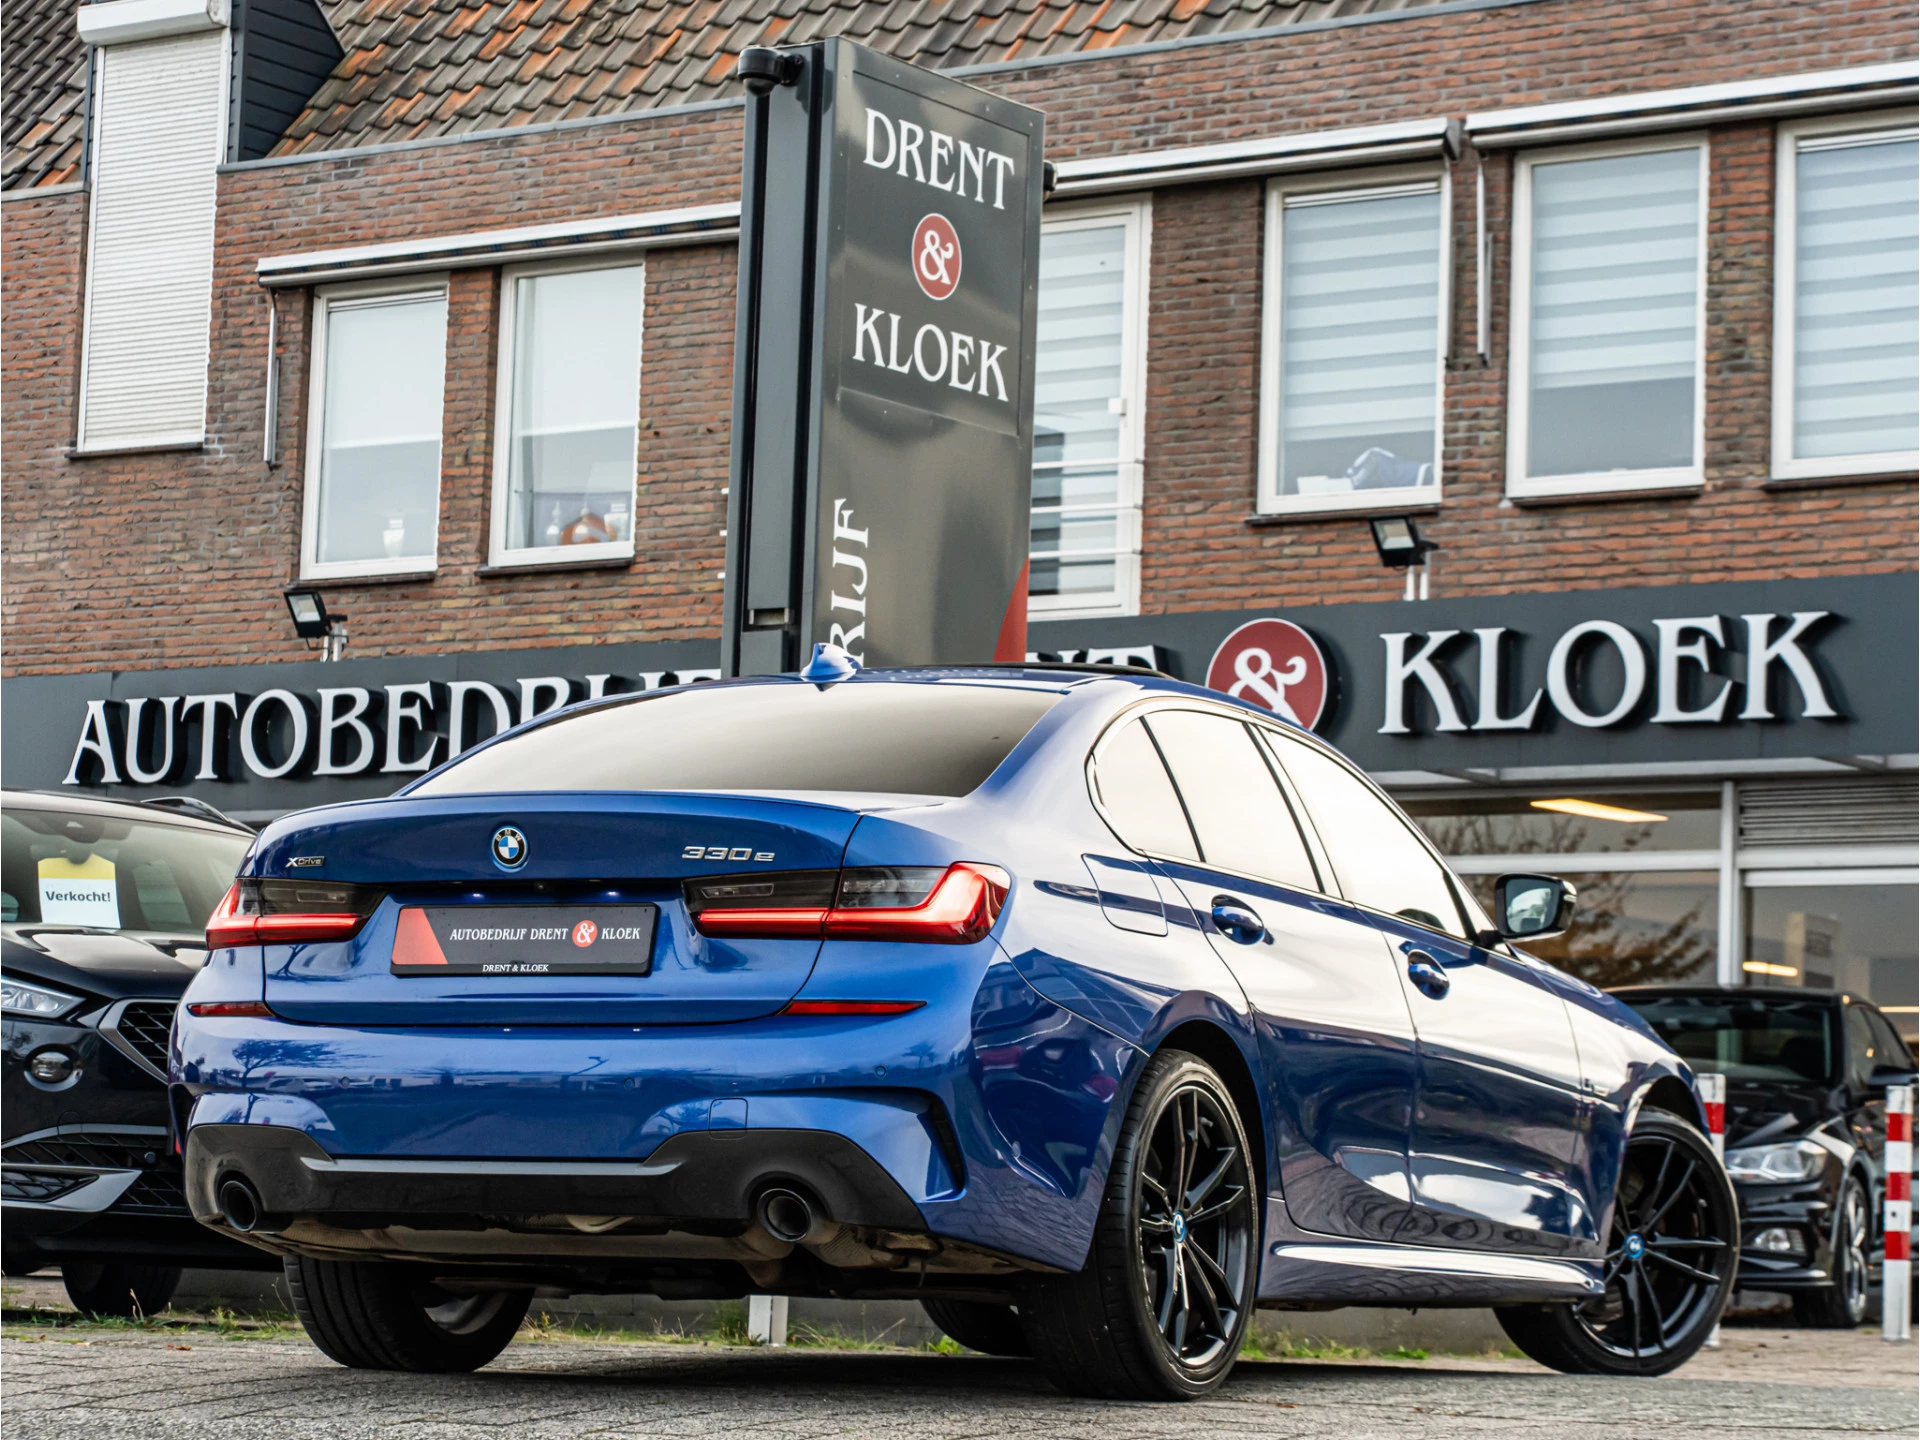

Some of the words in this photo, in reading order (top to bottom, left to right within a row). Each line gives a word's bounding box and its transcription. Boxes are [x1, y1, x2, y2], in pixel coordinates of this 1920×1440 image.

[863, 107, 1015, 210] DRENT
[920, 229, 954, 285] &
[852, 303, 1009, 402] KLOEK
[62, 669, 720, 785] AUTOBEDR
[1227, 647, 1307, 728] &
[1377, 611, 1838, 734] KLOEK
[682, 846, 775, 862] 330e
[45, 891, 111, 902] Verkocht!
[449, 928, 528, 941] AUTOBEDRIJF
[529, 928, 569, 941] DRENT
[576, 923, 595, 944] &
[601, 927, 641, 940] KLOEK
[482, 964, 511, 973] DRENT
[511, 964, 519, 972] &
[520, 964, 549, 972] KLOEK
